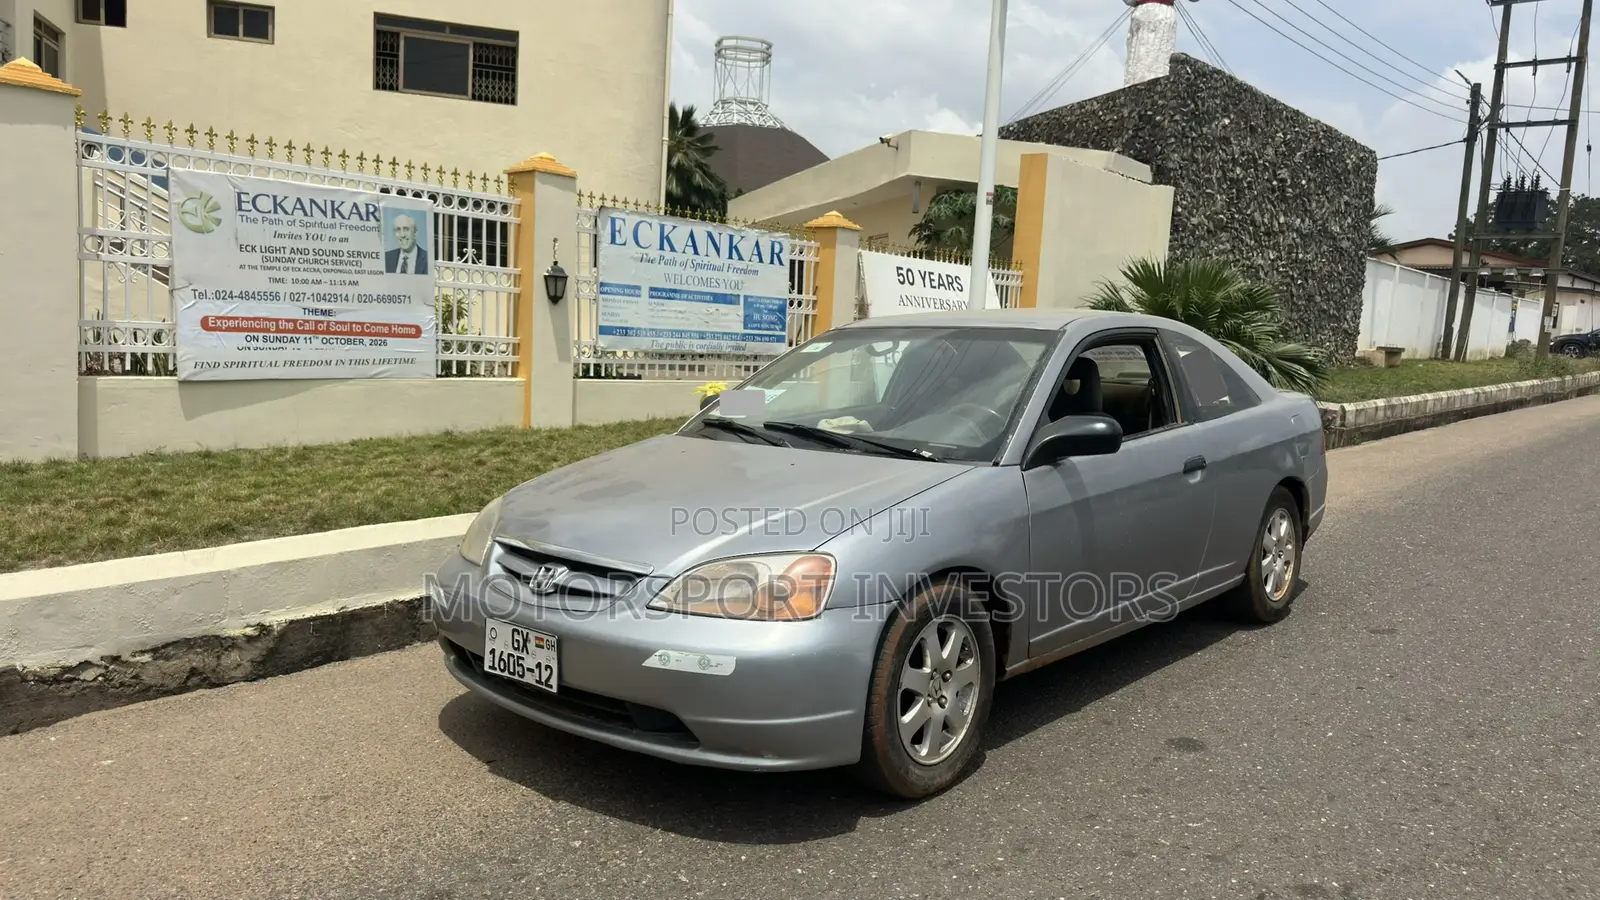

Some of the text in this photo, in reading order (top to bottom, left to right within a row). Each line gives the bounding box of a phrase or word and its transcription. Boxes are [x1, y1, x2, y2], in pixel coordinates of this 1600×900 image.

[236, 191, 380, 222] ECKANKAR
[239, 214, 380, 233] The Path of Spiritual Freedom
[273, 230, 303, 241] Invites
[305, 232, 327, 242] YOU
[328, 234, 337, 242] to
[608, 215, 785, 266] ECKANKAR
[239, 244, 380, 260] ECK LIGHT AND SOUND SERVICE
[261, 255, 362, 268] (SUNDAY CHURCH SERVICE)
[639, 252, 759, 276] The Path of Spiritual Freedom
[268, 277, 288, 285] TIME:
[291, 277, 310, 285] 10:00
[310, 278, 322, 286] AM
[664, 272, 744, 291] WELCOMES YOU
[895, 266, 964, 293] 50 YEARS
[289, 291, 349, 303] 027-1042914
[357, 293, 412, 304] 020-6690571
[600, 286, 624, 294] OPENING
[302, 307, 337, 317] THEME:
[208, 316, 416, 335] Experiencing the Call of Soul to Come Home
[245, 334, 259, 343] ON
[262, 335, 301, 344] SUNDAY
[321, 336, 367, 347] OCTOBER,
[369, 338, 388, 347] 2026
[651, 340, 747, 352] The public is cordially invited
[193, 357, 417, 369] FIND SPIRITUAL FREEDOM IN THIS LIFETIME
[511, 627, 556, 655] GX GH
[488, 647, 554, 690] 1605-12
